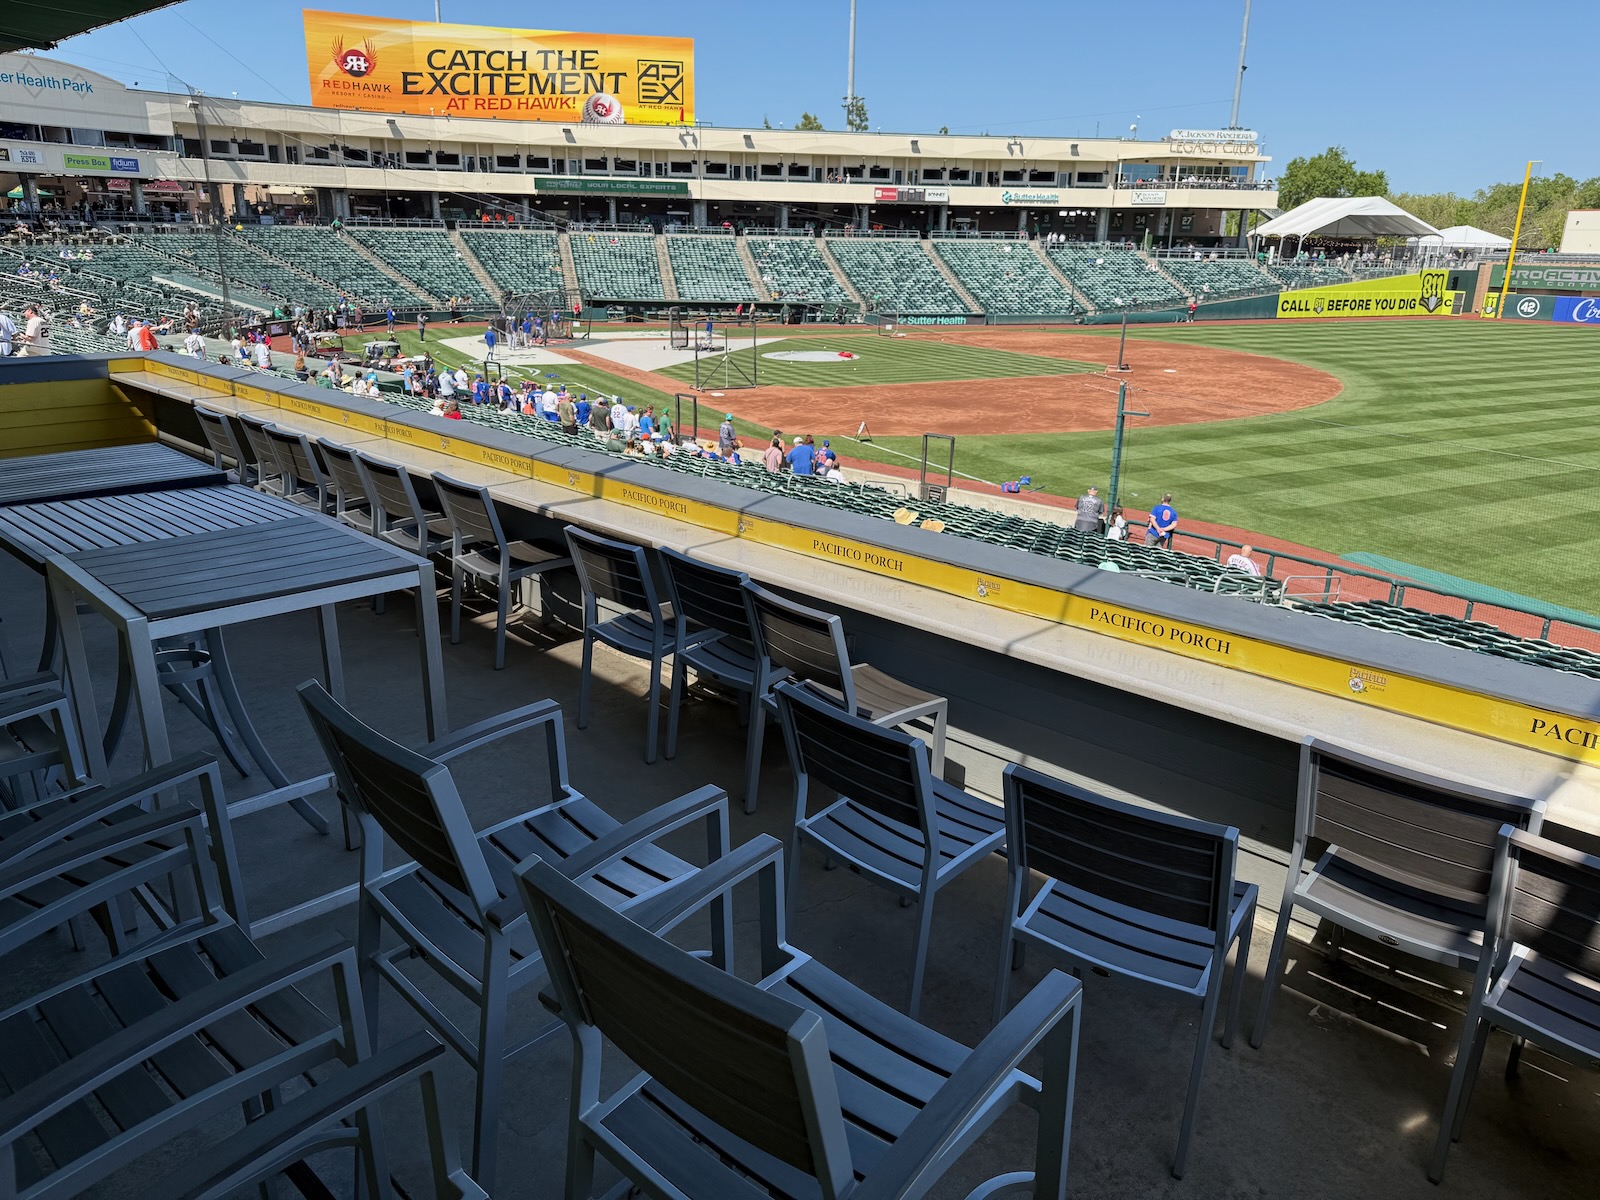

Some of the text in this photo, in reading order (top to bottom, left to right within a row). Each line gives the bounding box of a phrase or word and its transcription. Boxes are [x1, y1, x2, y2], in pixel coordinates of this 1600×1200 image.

[426, 49, 599, 71] CATCH THE
[16, 72, 61, 89] Health
[62, 78, 94, 93] Park
[322, 79, 392, 93] REDHAWK
[401, 71, 628, 96] EXCITEMENT
[446, 97, 576, 110] AT RED HAWK!
[1216, 131, 1252, 140] RANCHERIA
[1169, 141, 1256, 155] LEGACY CLUB
[67, 157, 107, 167] Press Box
[1135, 215, 1146, 225] 34
[1181, 215, 1193, 225] 27
[1422, 273, 1445, 299] 811
[1281, 297, 1417, 312] CALL 811 BEFORE YOU DIG
[1520, 301, 1536, 313] 42
[907, 315, 967, 325] Sutter Health
[613, 410, 621, 419] 22
[482, 450, 532, 472] PACIFICO PORCH
[622, 487, 688, 514] PACIFICO PORCH
[812, 538, 903, 572] PACIFICO PORCH
[1089, 607, 1232, 655] PACIFICO PORCH
[1349, 667, 1388, 686] PACIFICO
